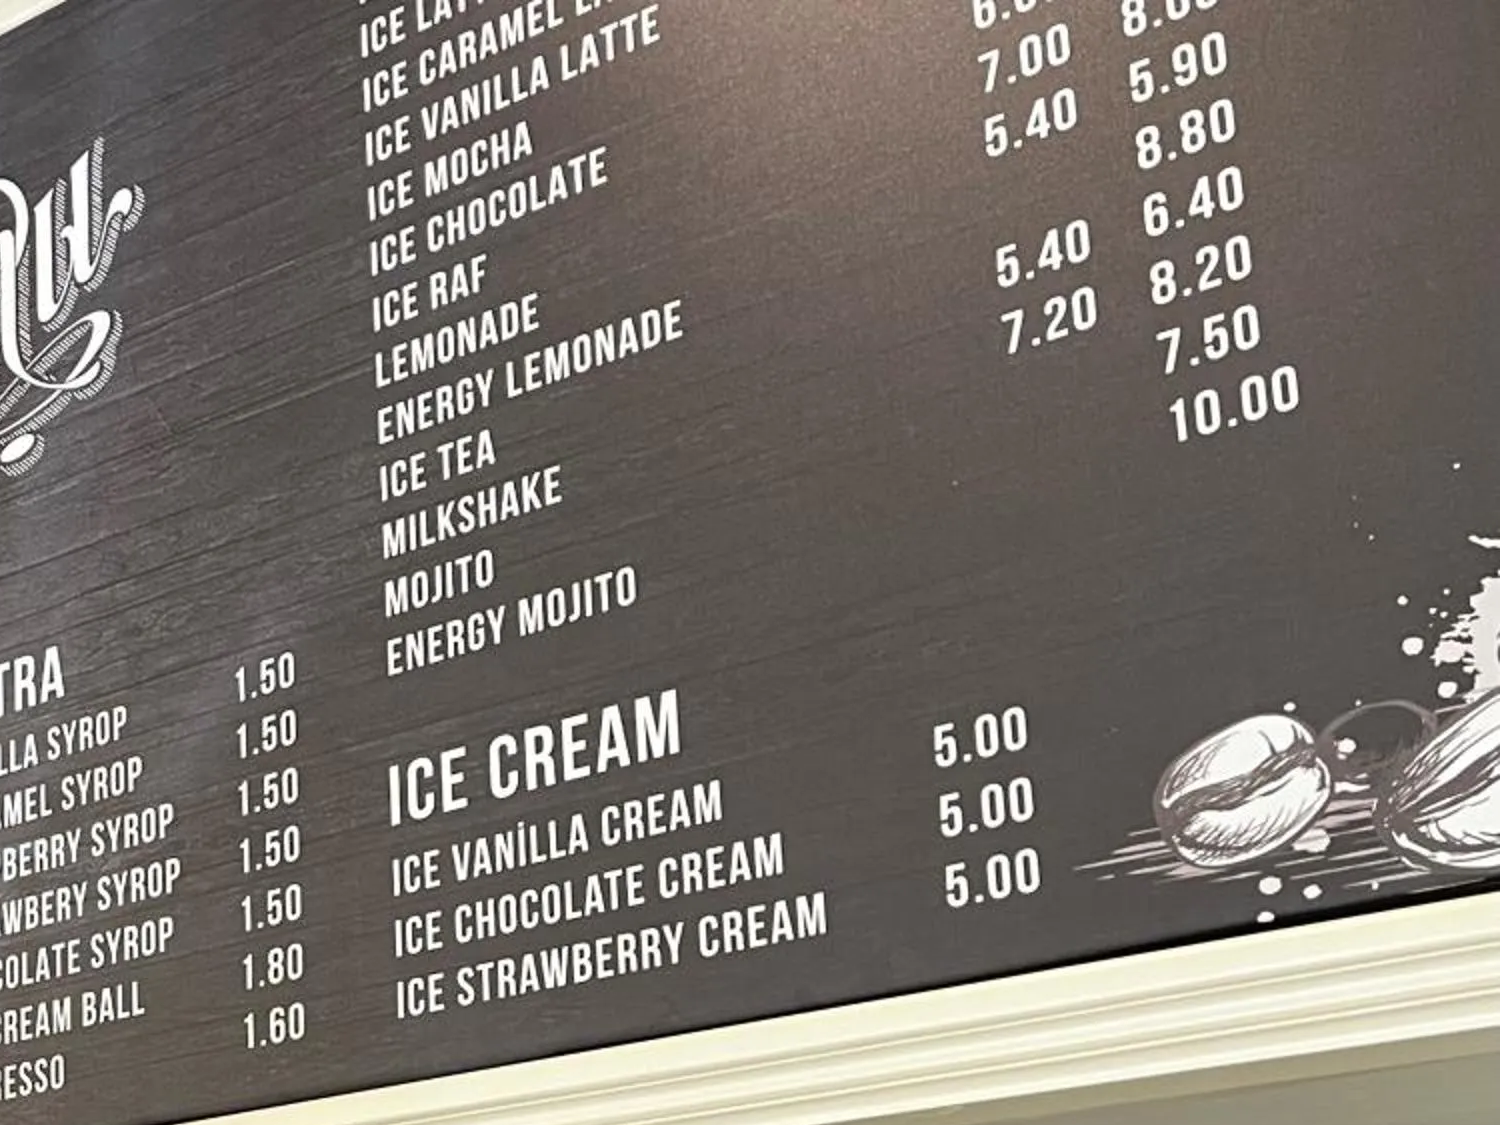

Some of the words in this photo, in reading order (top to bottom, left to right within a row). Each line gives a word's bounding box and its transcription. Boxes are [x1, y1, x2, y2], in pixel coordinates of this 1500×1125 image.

[360, 5, 406, 58] ICE
[363, 60, 409, 113] ICE
[419, 0, 564, 86] CARAMEL
[977, 23, 1071, 93] 7.00
[365, 115, 411, 167] ICE
[420, 55, 550, 141] VANILLA
[560, 3, 661, 81] LATTE
[1129, 31, 1227, 103] 5.90
[984, 87, 1077, 157] 5.40
[1135, 98, 1236, 169] 8.80
[367, 170, 414, 221] ICE
[424, 121, 533, 197] MOCHA
[1143, 166, 1244, 237] 6.40
[370, 225, 417, 277] ICE
[427, 146, 608, 252] CHOCOLATE
[996, 219, 1091, 288] 5.40
[1149, 235, 1252, 305] 8.20
[373, 281, 419, 332] ICE
[429, 254, 487, 310] RAF
[1001, 286, 1097, 354] 7.20
[375, 292, 539, 388] LEMONADE
[377, 368, 494, 445] ENERGY
[506, 299, 683, 398] LEMONADE
[1156, 304, 1260, 374] 7.50
[1169, 365, 1299, 442] 10.00
[380, 451, 427, 502] ICE
[436, 429, 496, 481] TEA
[382, 465, 563, 559] MILKSHAKE
[385, 549, 494, 618] MOJITO
[387, 605, 506, 676] ENERGY
[518, 566, 637, 637] MOJITO
[235, 651, 295, 702] 1.50
[47, 705, 127, 761] SYROP
[236, 709, 297, 759] 1.50
[389, 746, 469, 827] ICE
[489, 689, 680, 799] CREAM
[933, 706, 1027, 768] 5.00
[61, 755, 143, 811] SYROP
[238, 767, 299, 817] 1.50
[939, 777, 1034, 837] 5.00
[90, 803, 174, 857] SYROP
[239, 825, 300, 874] 1.50
[392, 849, 441, 897] ICE
[601, 779, 723, 846] CREAM
[97, 857, 181, 911] SYROP
[241, 883, 302, 932] 1.50
[395, 910, 444, 958] ICE
[454, 863, 645, 944] CHOCOLATE
[658, 832, 783, 899] CREAM
[945, 847, 1041, 908] 5.00
[90, 916, 174, 969] SYROP
[243, 943, 303, 990] 1.80
[397, 972, 445, 1019] ICE
[456, 921, 684, 1007] STRAWBERRY
[698, 891, 827, 958] CREAM
[81, 981, 145, 1027] BALL
[243, 1002, 305, 1049] 1.60
